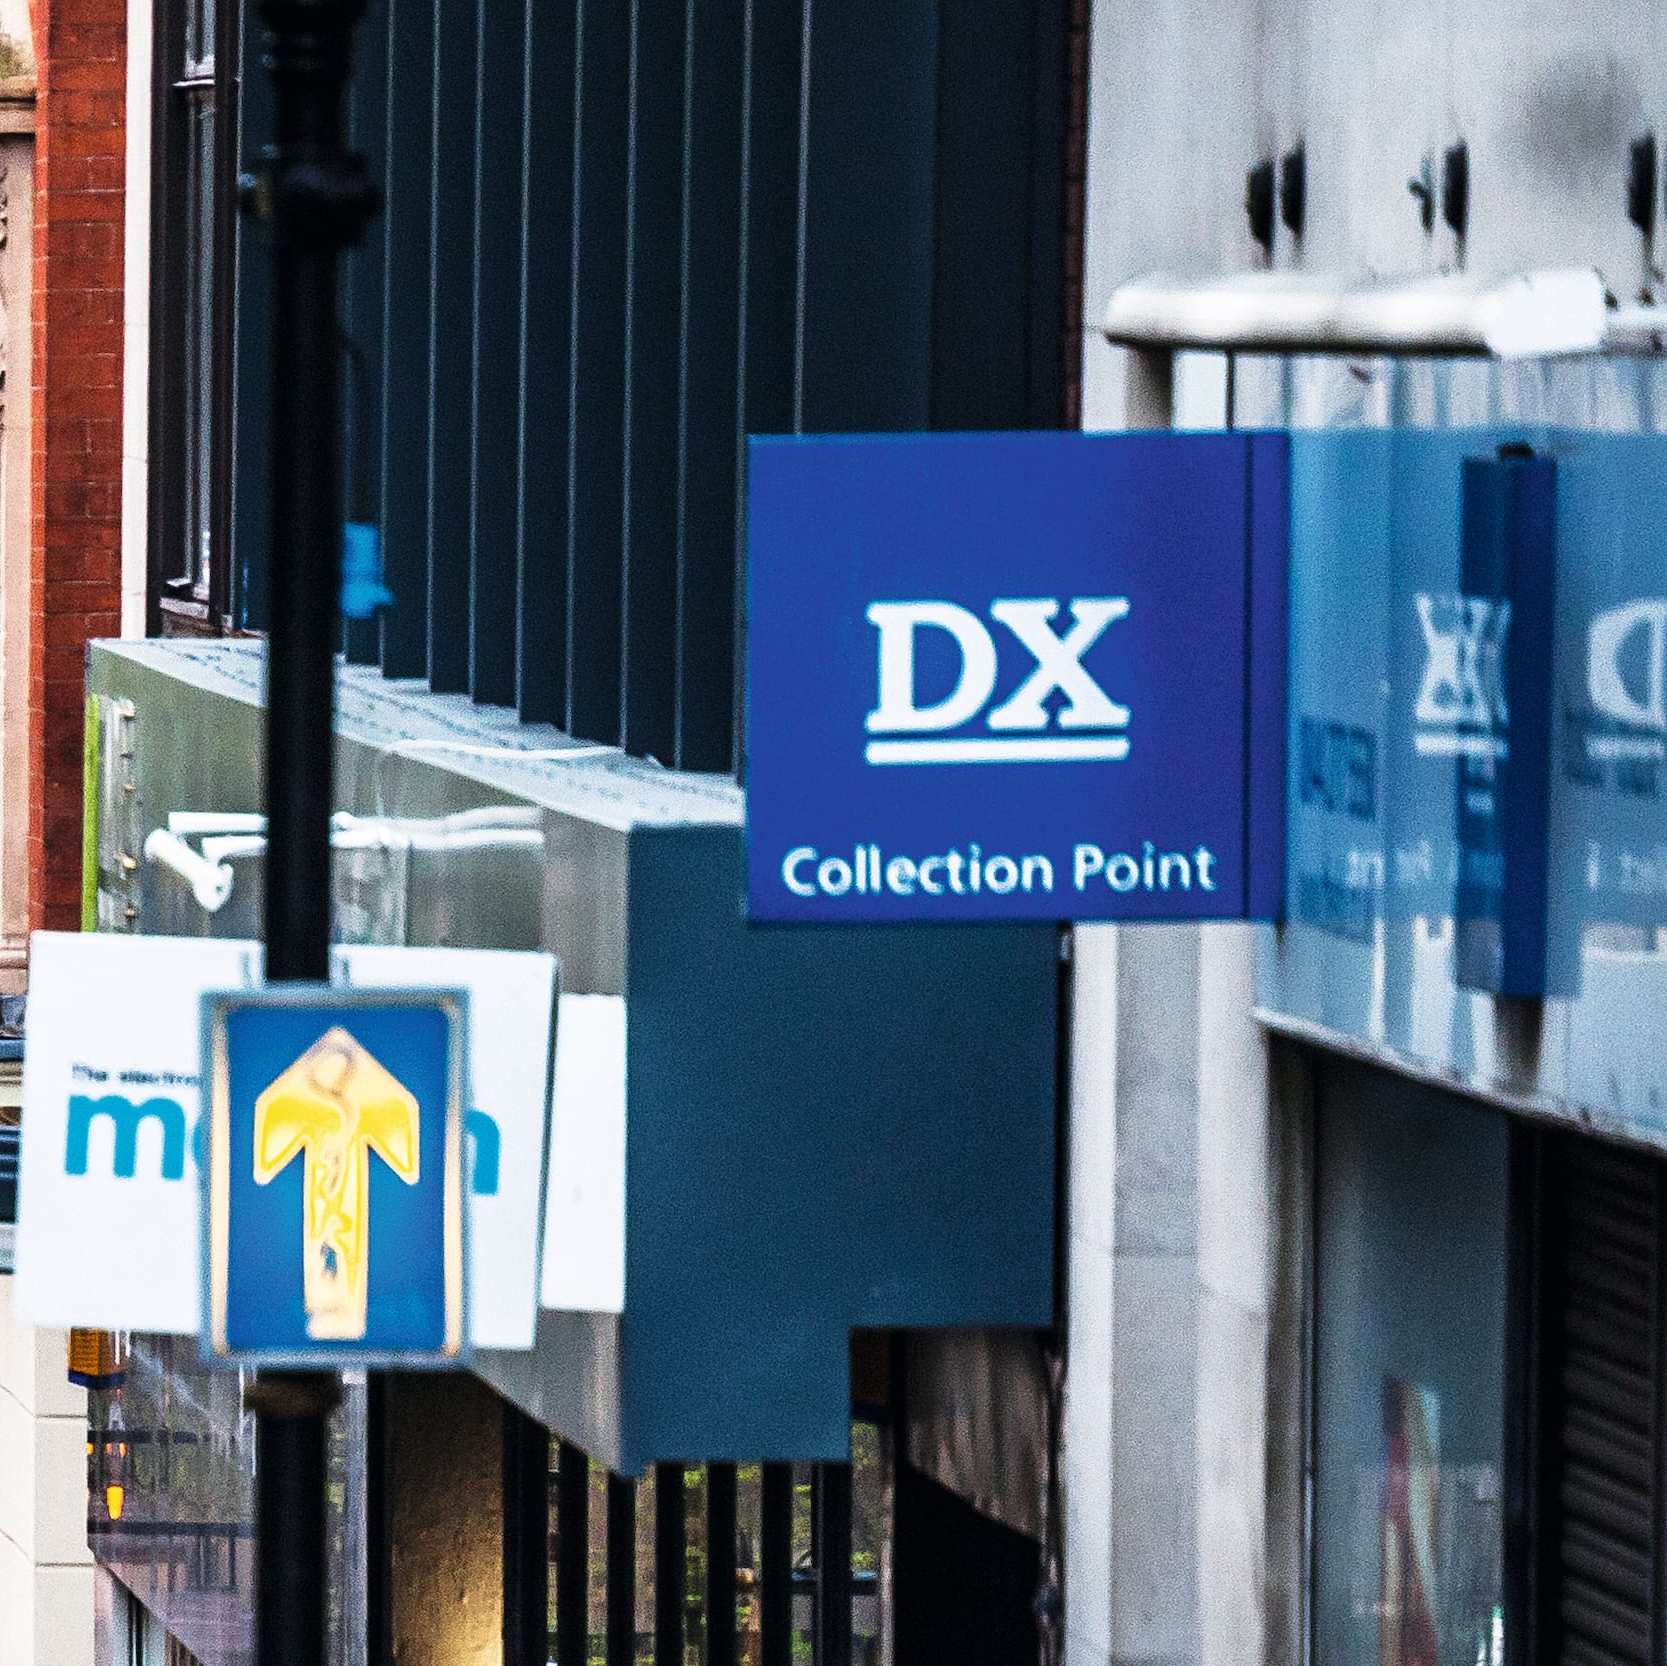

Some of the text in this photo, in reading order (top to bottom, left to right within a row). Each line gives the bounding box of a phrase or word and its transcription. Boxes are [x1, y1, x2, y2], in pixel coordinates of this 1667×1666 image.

[865, 597, 1132, 734] DX
[781, 840, 1217, 897] Collection Point
